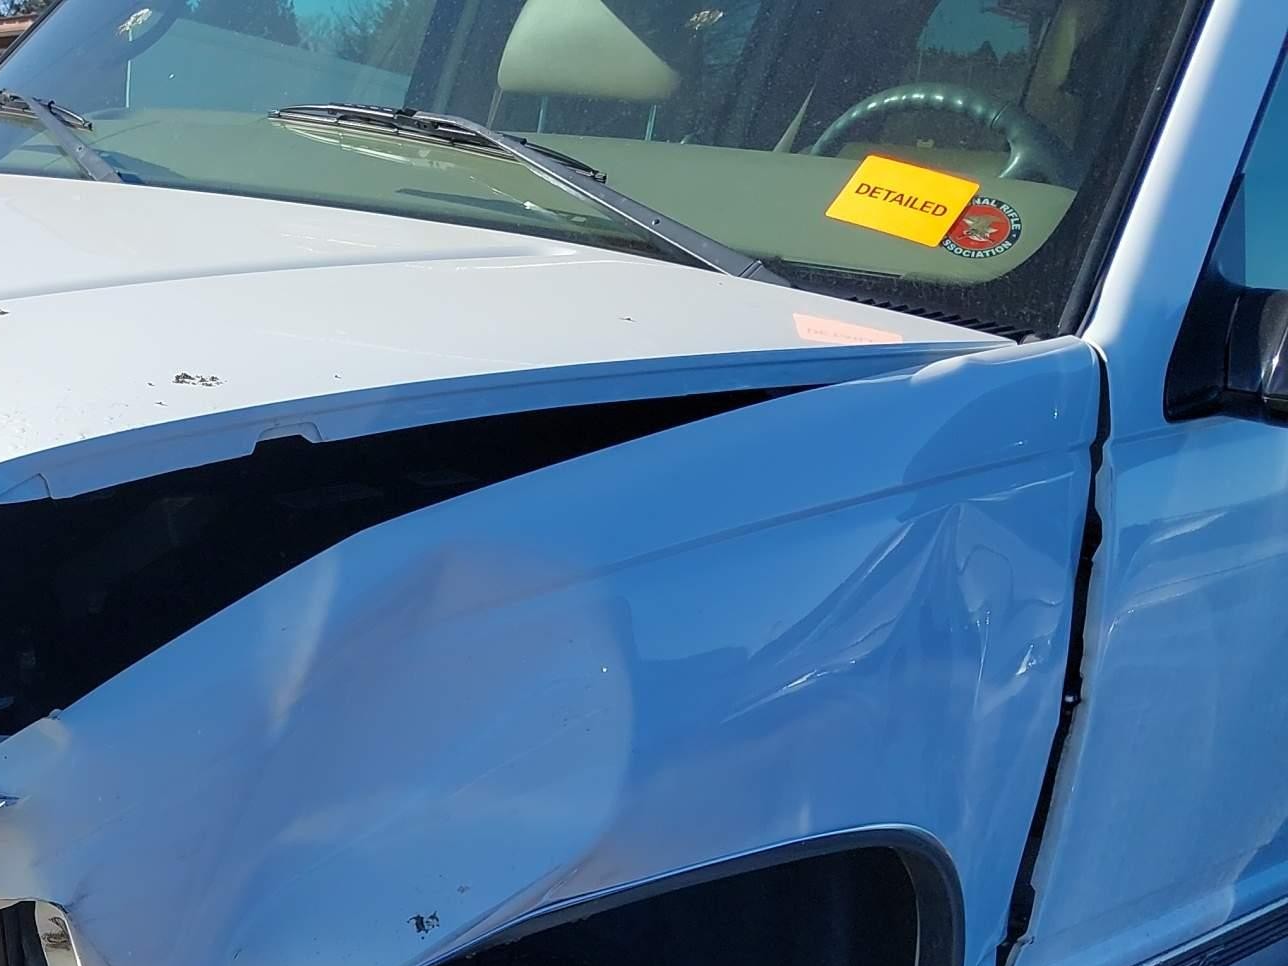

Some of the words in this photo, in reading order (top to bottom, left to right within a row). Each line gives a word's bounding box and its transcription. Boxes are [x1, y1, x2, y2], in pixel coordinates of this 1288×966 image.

[855, 182, 949, 217] DETAILED
[999, 204, 1021, 231] RIFLE
[942, 239, 1013, 258] SSOCIATION
